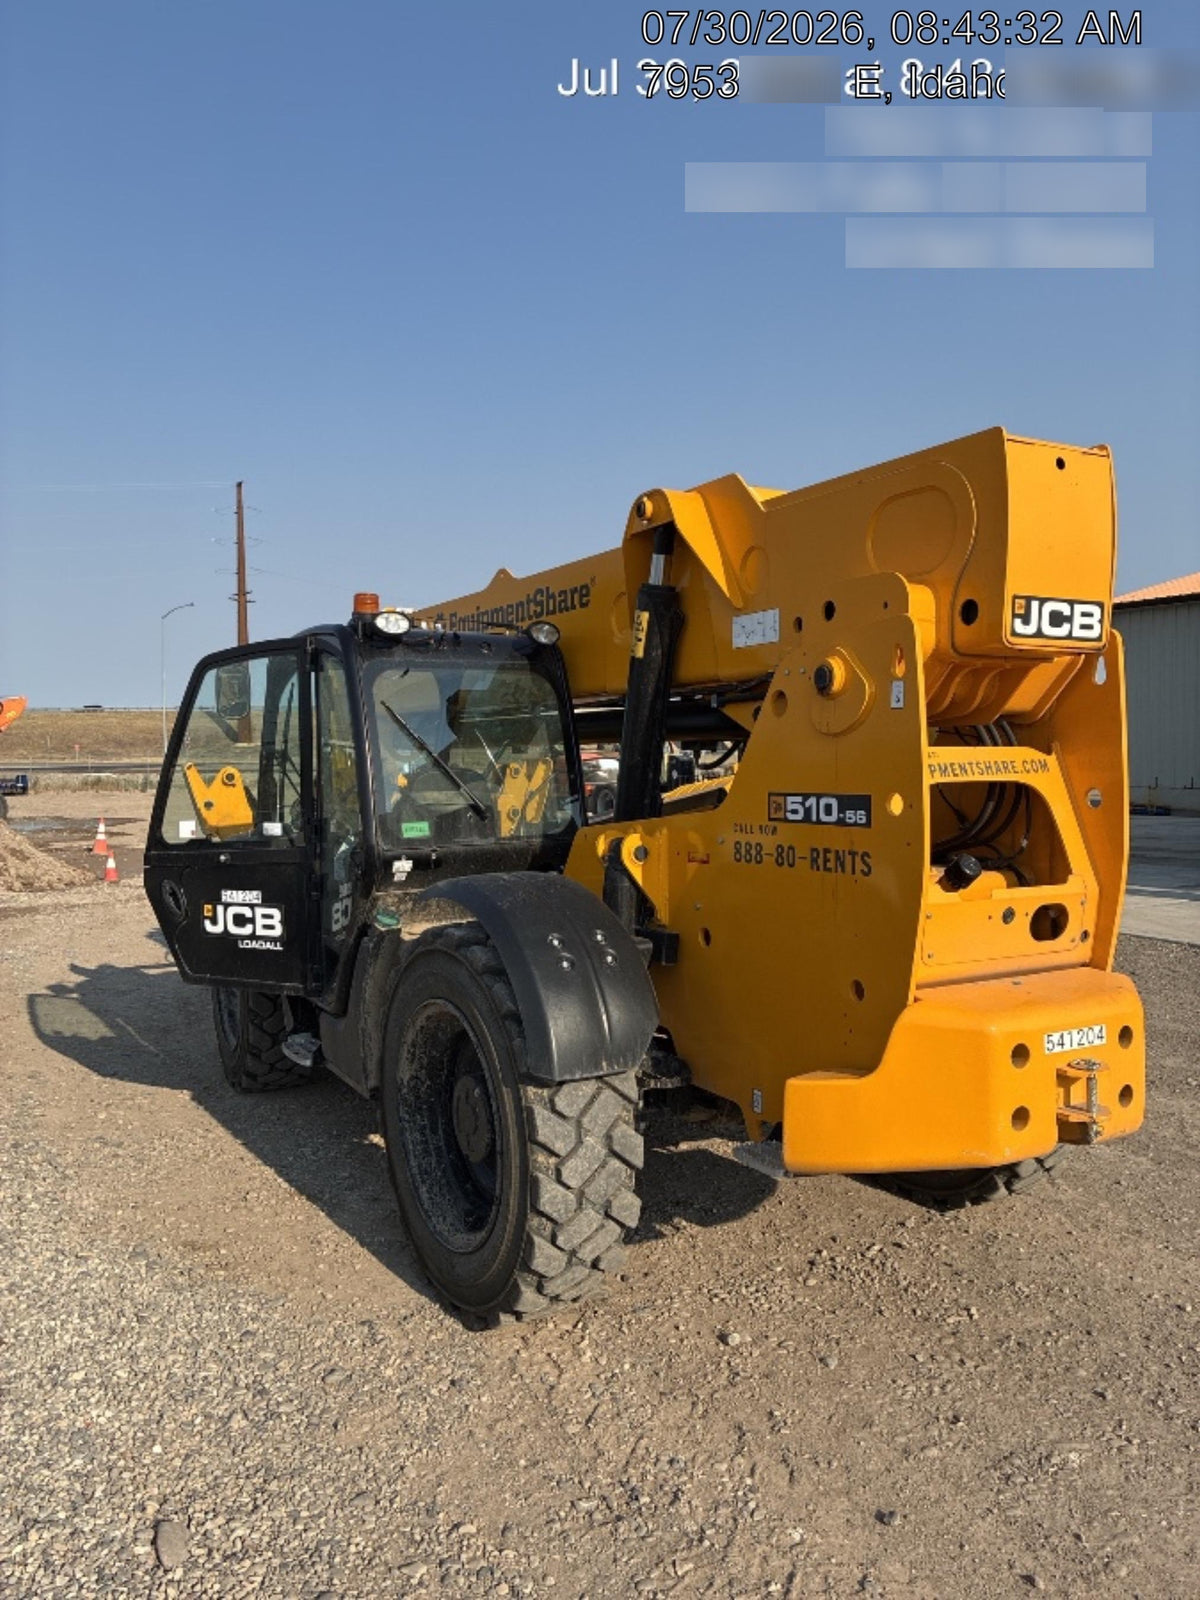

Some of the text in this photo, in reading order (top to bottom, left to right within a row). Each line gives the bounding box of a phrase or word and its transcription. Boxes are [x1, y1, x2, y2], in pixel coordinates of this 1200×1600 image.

[1013, 600, 1101, 639] JCB
[786, 796, 867, 824] 510-56
[733, 823, 778, 836] CALL NOW
[733, 841, 872, 877] 888-80-RENTS
[204, 904, 283, 937] JCB
[238, 939, 284, 950] LOADALL
[1046, 1025, 1104, 1053] 541204
